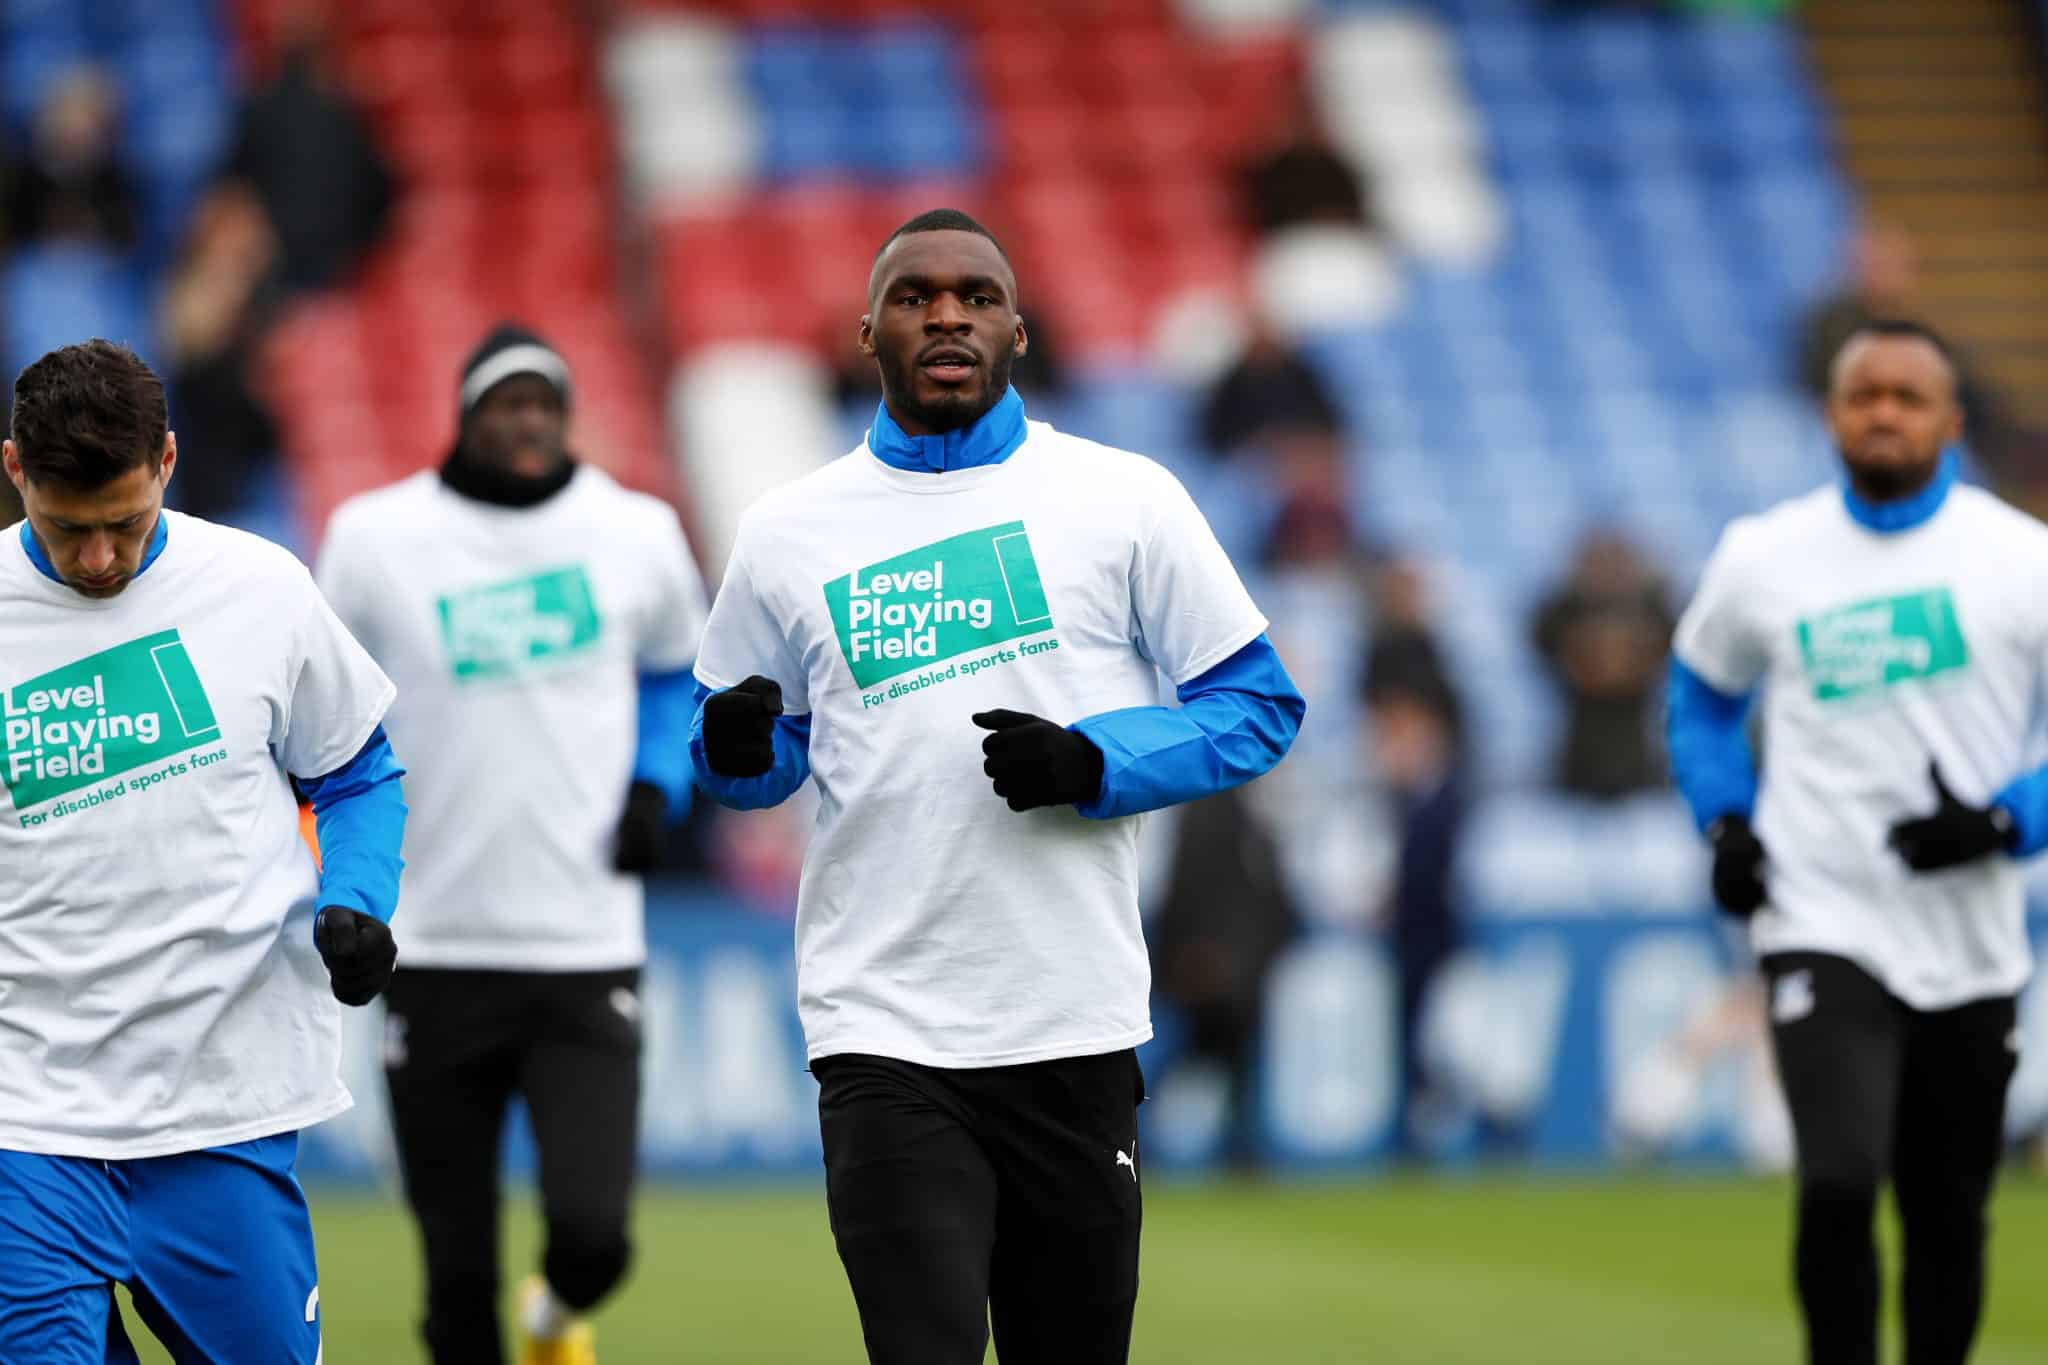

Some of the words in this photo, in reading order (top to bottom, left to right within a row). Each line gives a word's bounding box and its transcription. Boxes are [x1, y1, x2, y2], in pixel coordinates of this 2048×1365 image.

[849, 560, 943, 597] Level
[849, 592, 993, 633] Playing
[851, 626, 937, 663] Field
[862, 692, 885, 709] For
[888, 665, 957, 698] disabled
[960, 648, 1017, 676] sports
[1019, 638, 1060, 657] fans
[3, 674, 105, 718] Level
[6, 707, 161, 751] Playing
[9, 743, 105, 783] Field
[19, 811, 49, 829] For
[53, 781, 126, 818] disabled
[130, 762, 187, 791] sports
[190, 748, 228, 769] fans
